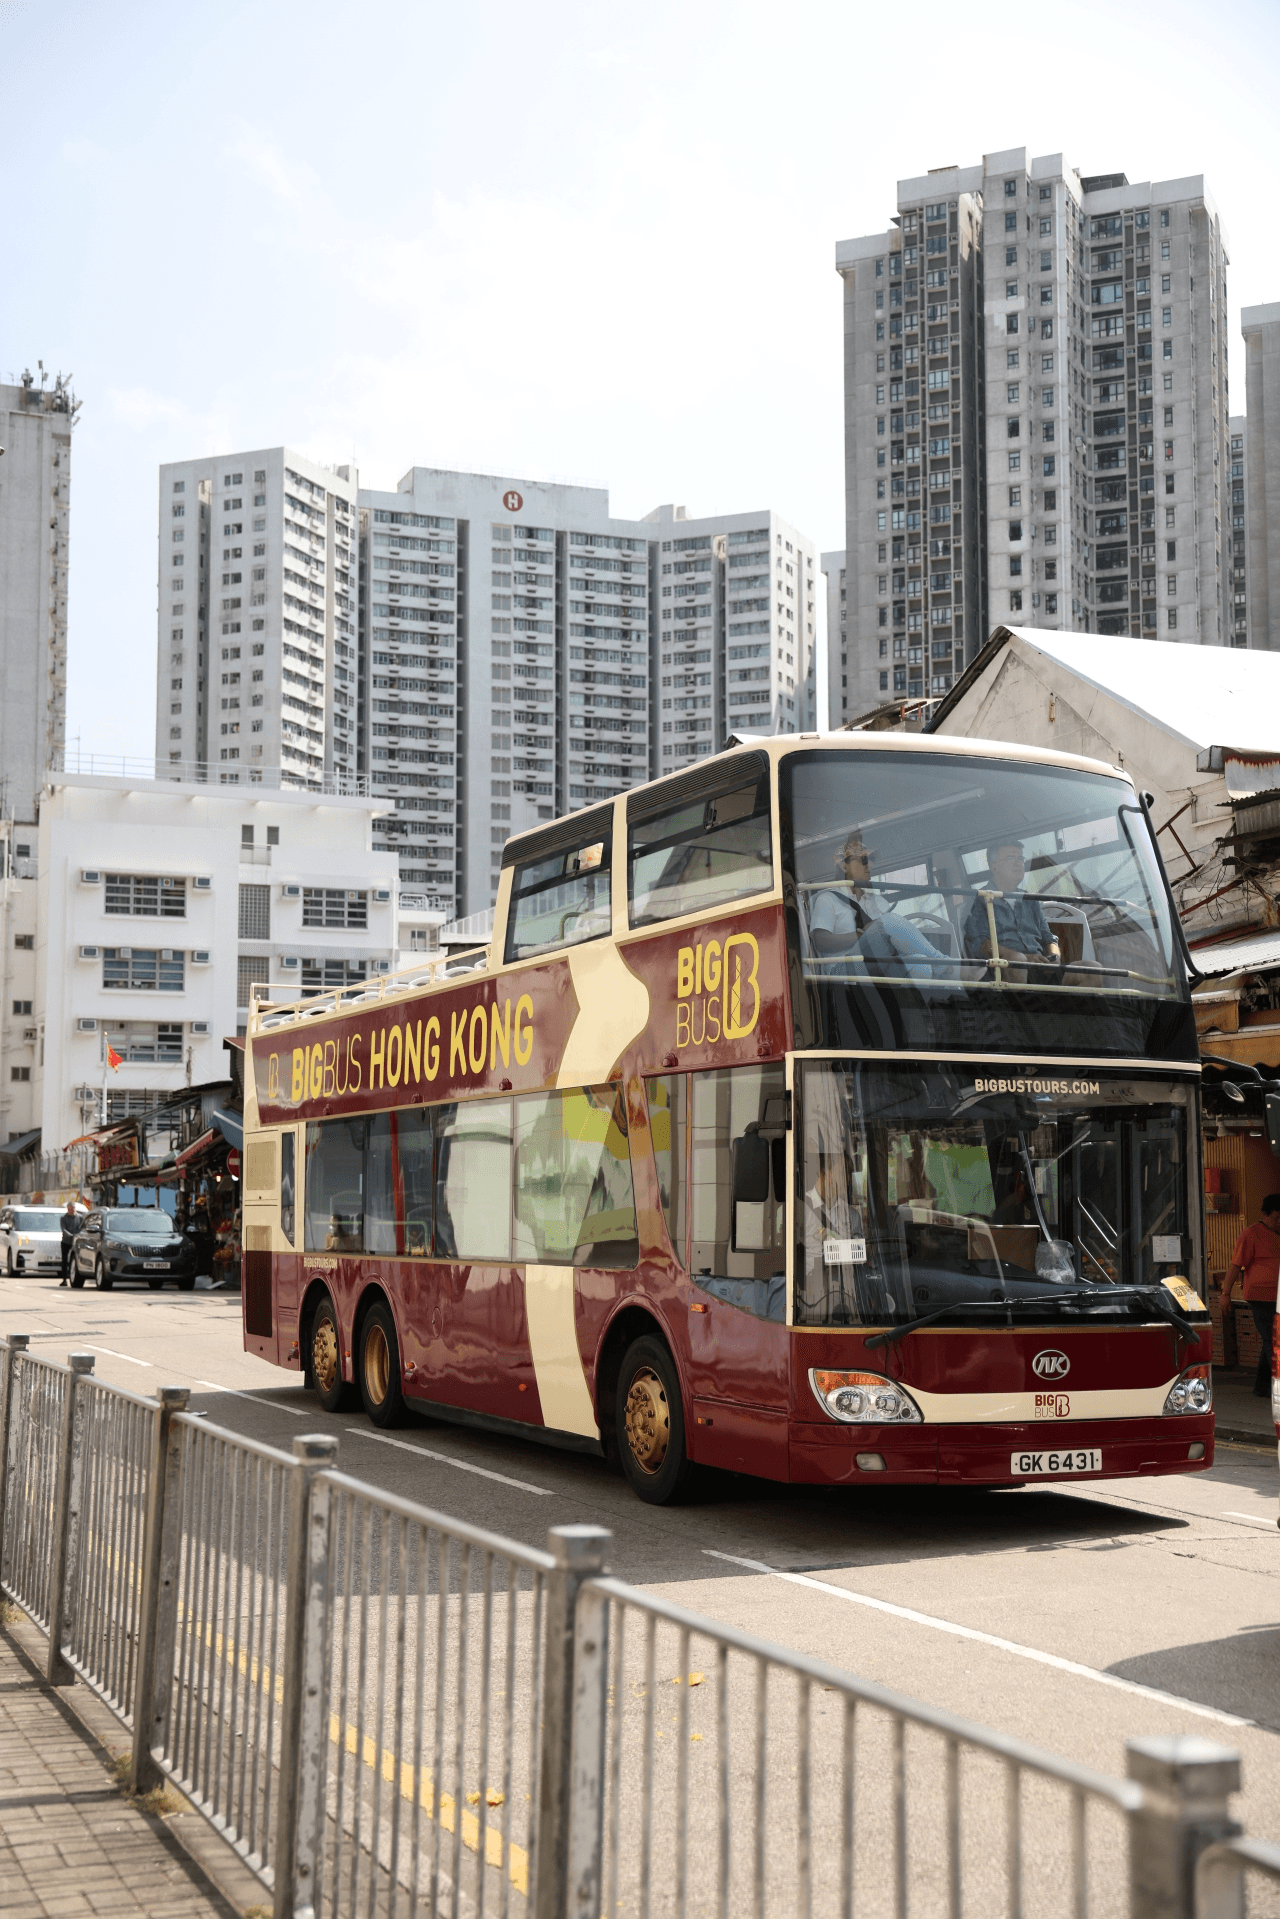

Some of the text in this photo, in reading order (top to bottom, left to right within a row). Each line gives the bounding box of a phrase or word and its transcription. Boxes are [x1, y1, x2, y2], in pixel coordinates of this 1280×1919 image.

[677, 940, 721, 998] BIG
[677, 996, 721, 1048] BUS
[369, 1015, 441, 1091] HONG
[449, 993, 534, 1078] KONG
[974, 1078, 1100, 1095] BIGBUSTOURS.COM
[1034, 1394, 1055, 1407] BIG
[1034, 1406, 1055, 1419] BUS
[1019, 1452, 1095, 1472] GK 6431
